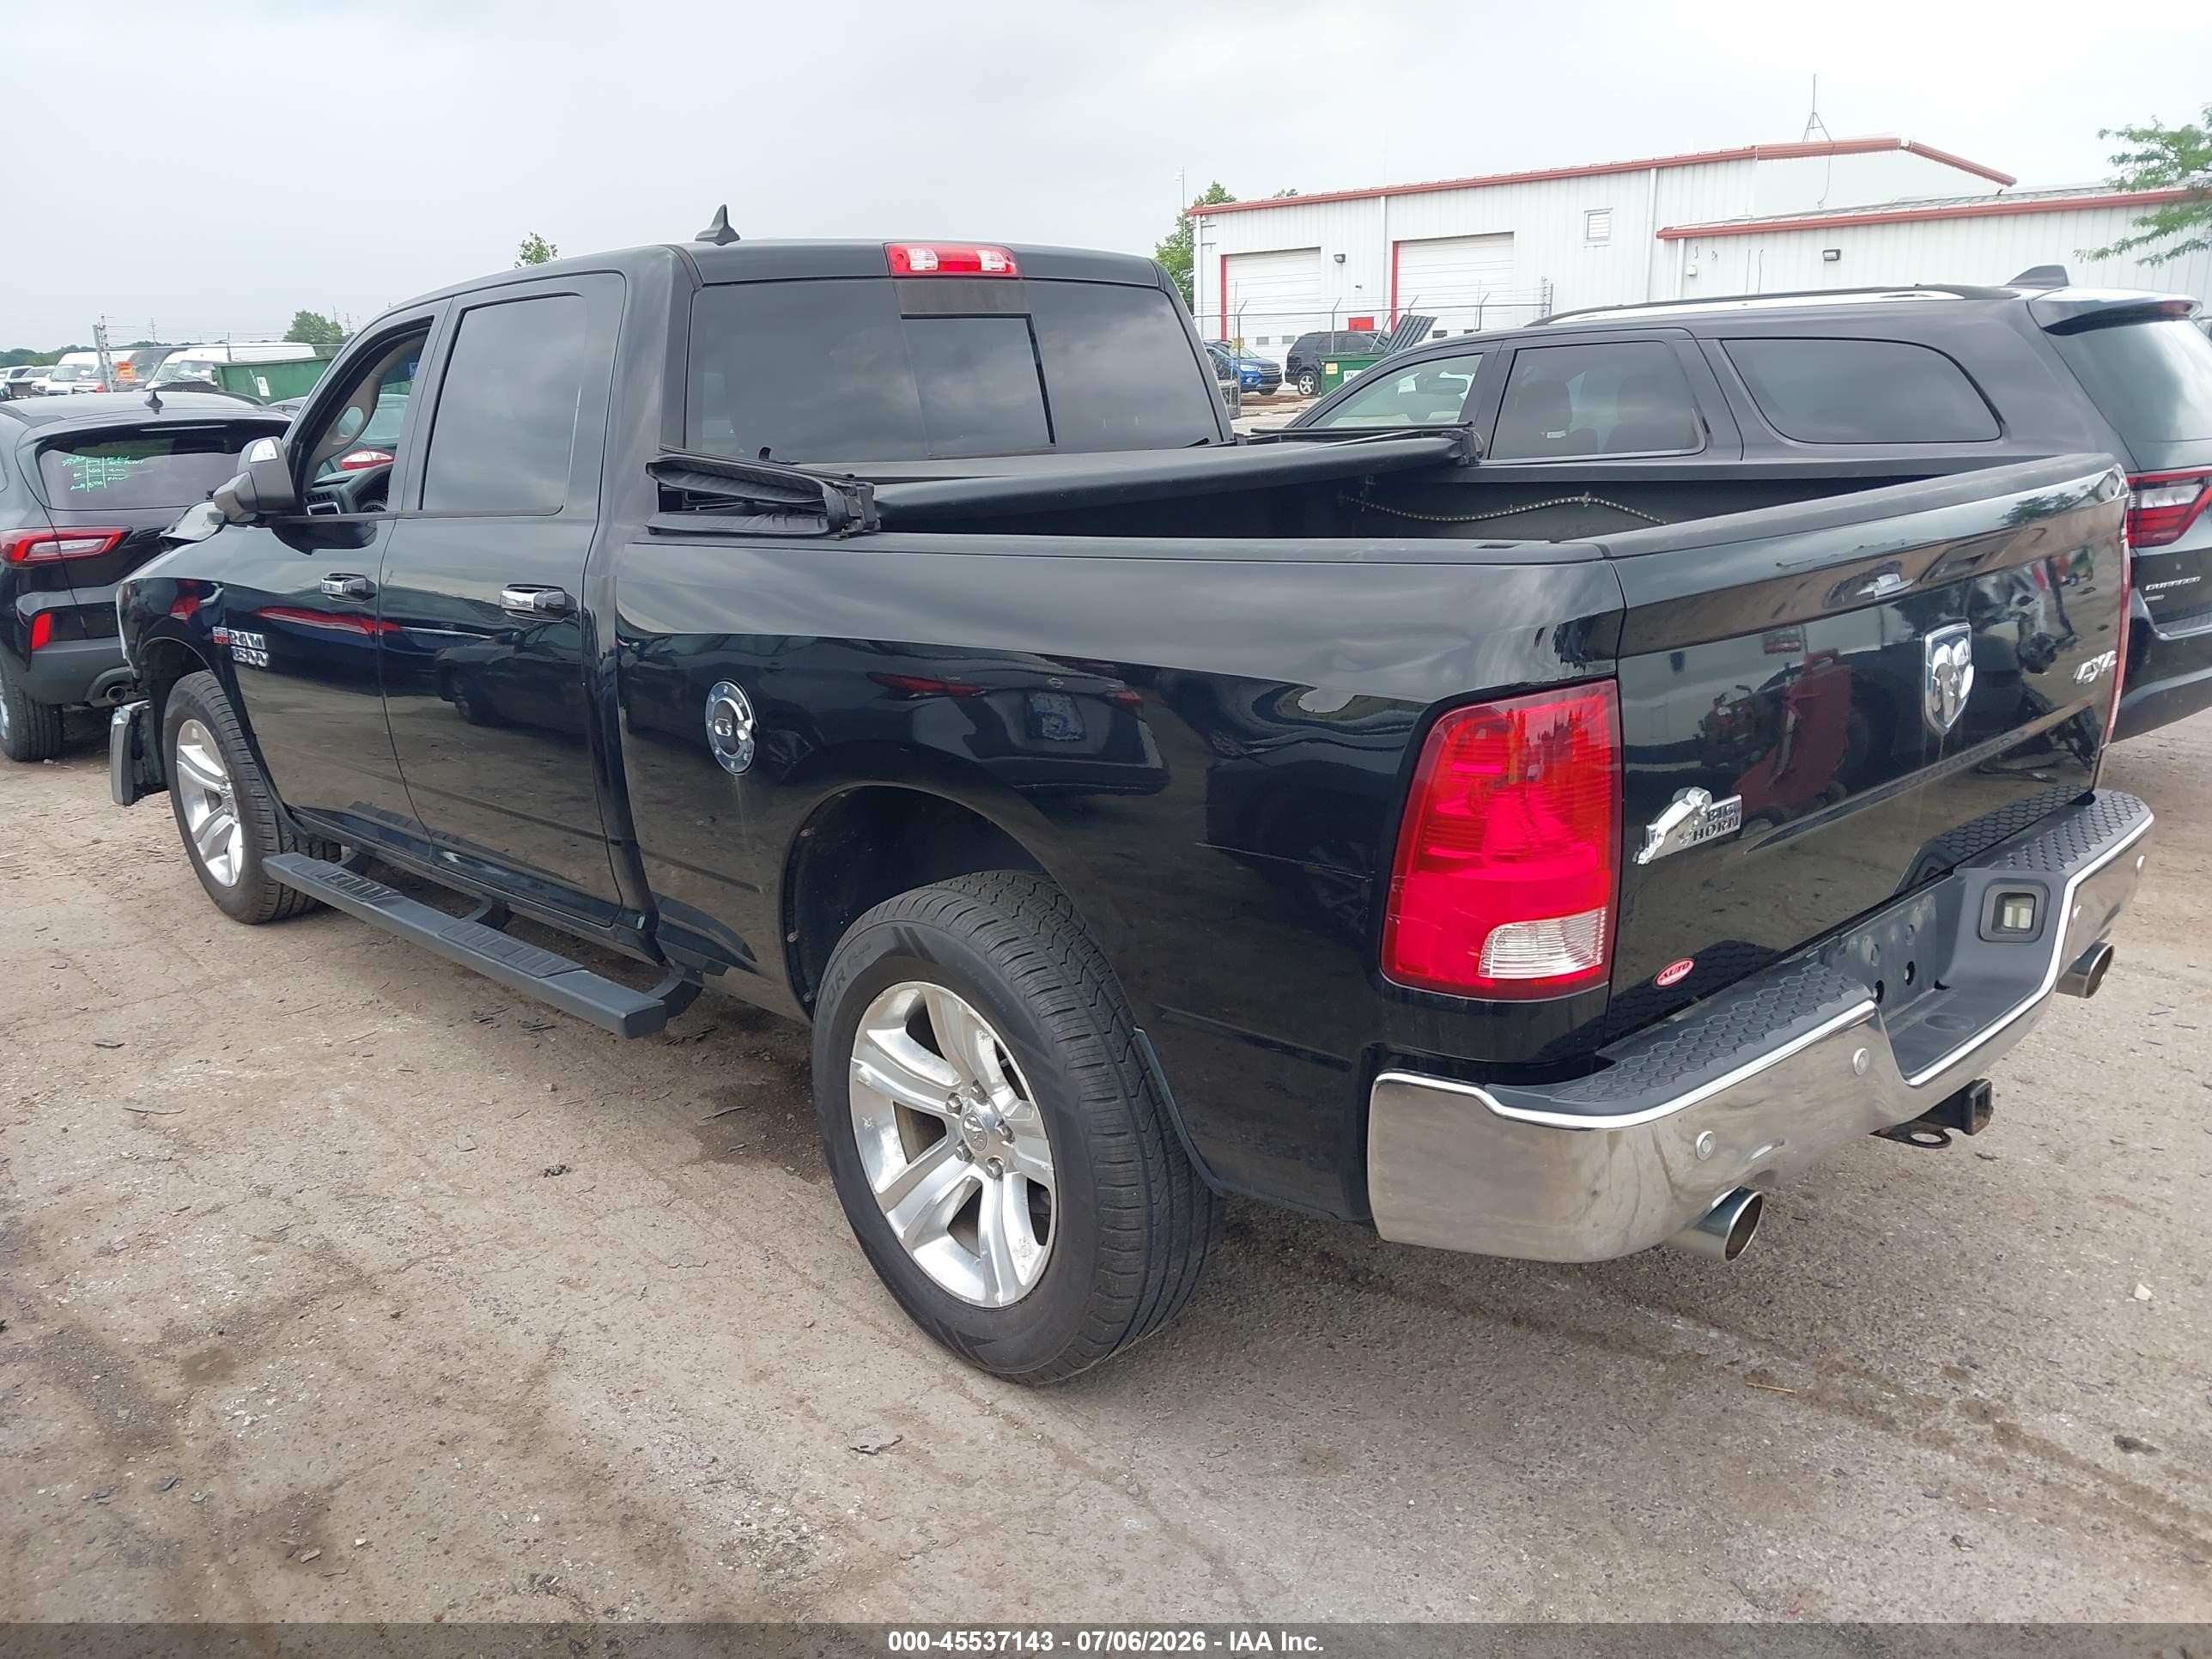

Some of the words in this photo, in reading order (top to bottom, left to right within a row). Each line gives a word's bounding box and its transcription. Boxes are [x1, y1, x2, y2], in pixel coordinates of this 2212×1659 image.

[2145, 576, 2201, 592] DURANGO
[228, 629, 266, 650] RAM
[1707, 804, 1735, 823] BIG
[1692, 817, 1739, 842] HORN
